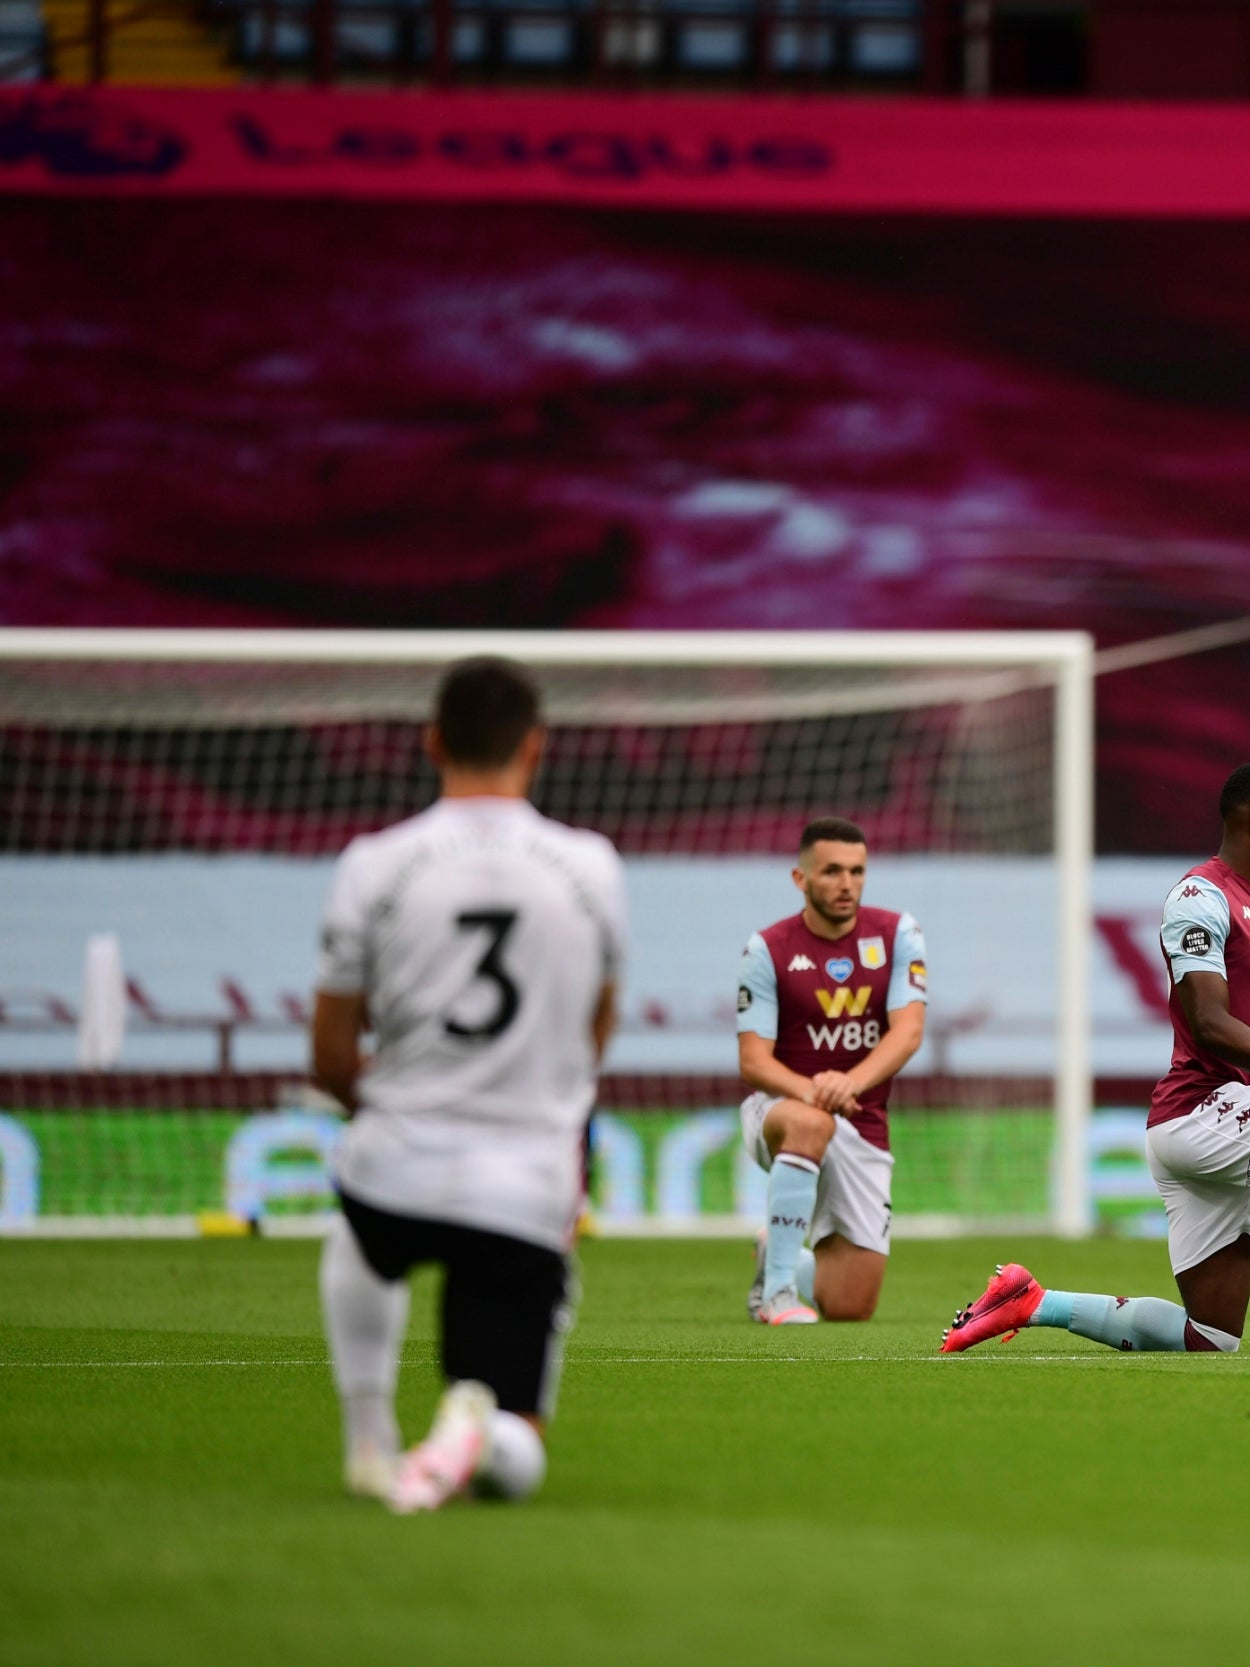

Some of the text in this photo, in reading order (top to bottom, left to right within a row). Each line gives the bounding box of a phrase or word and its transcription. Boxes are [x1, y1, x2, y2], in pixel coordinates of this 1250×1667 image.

[228, 112, 836, 180] League
[444, 908, 521, 1038] 3
[806, 1020, 880, 1051] W88
